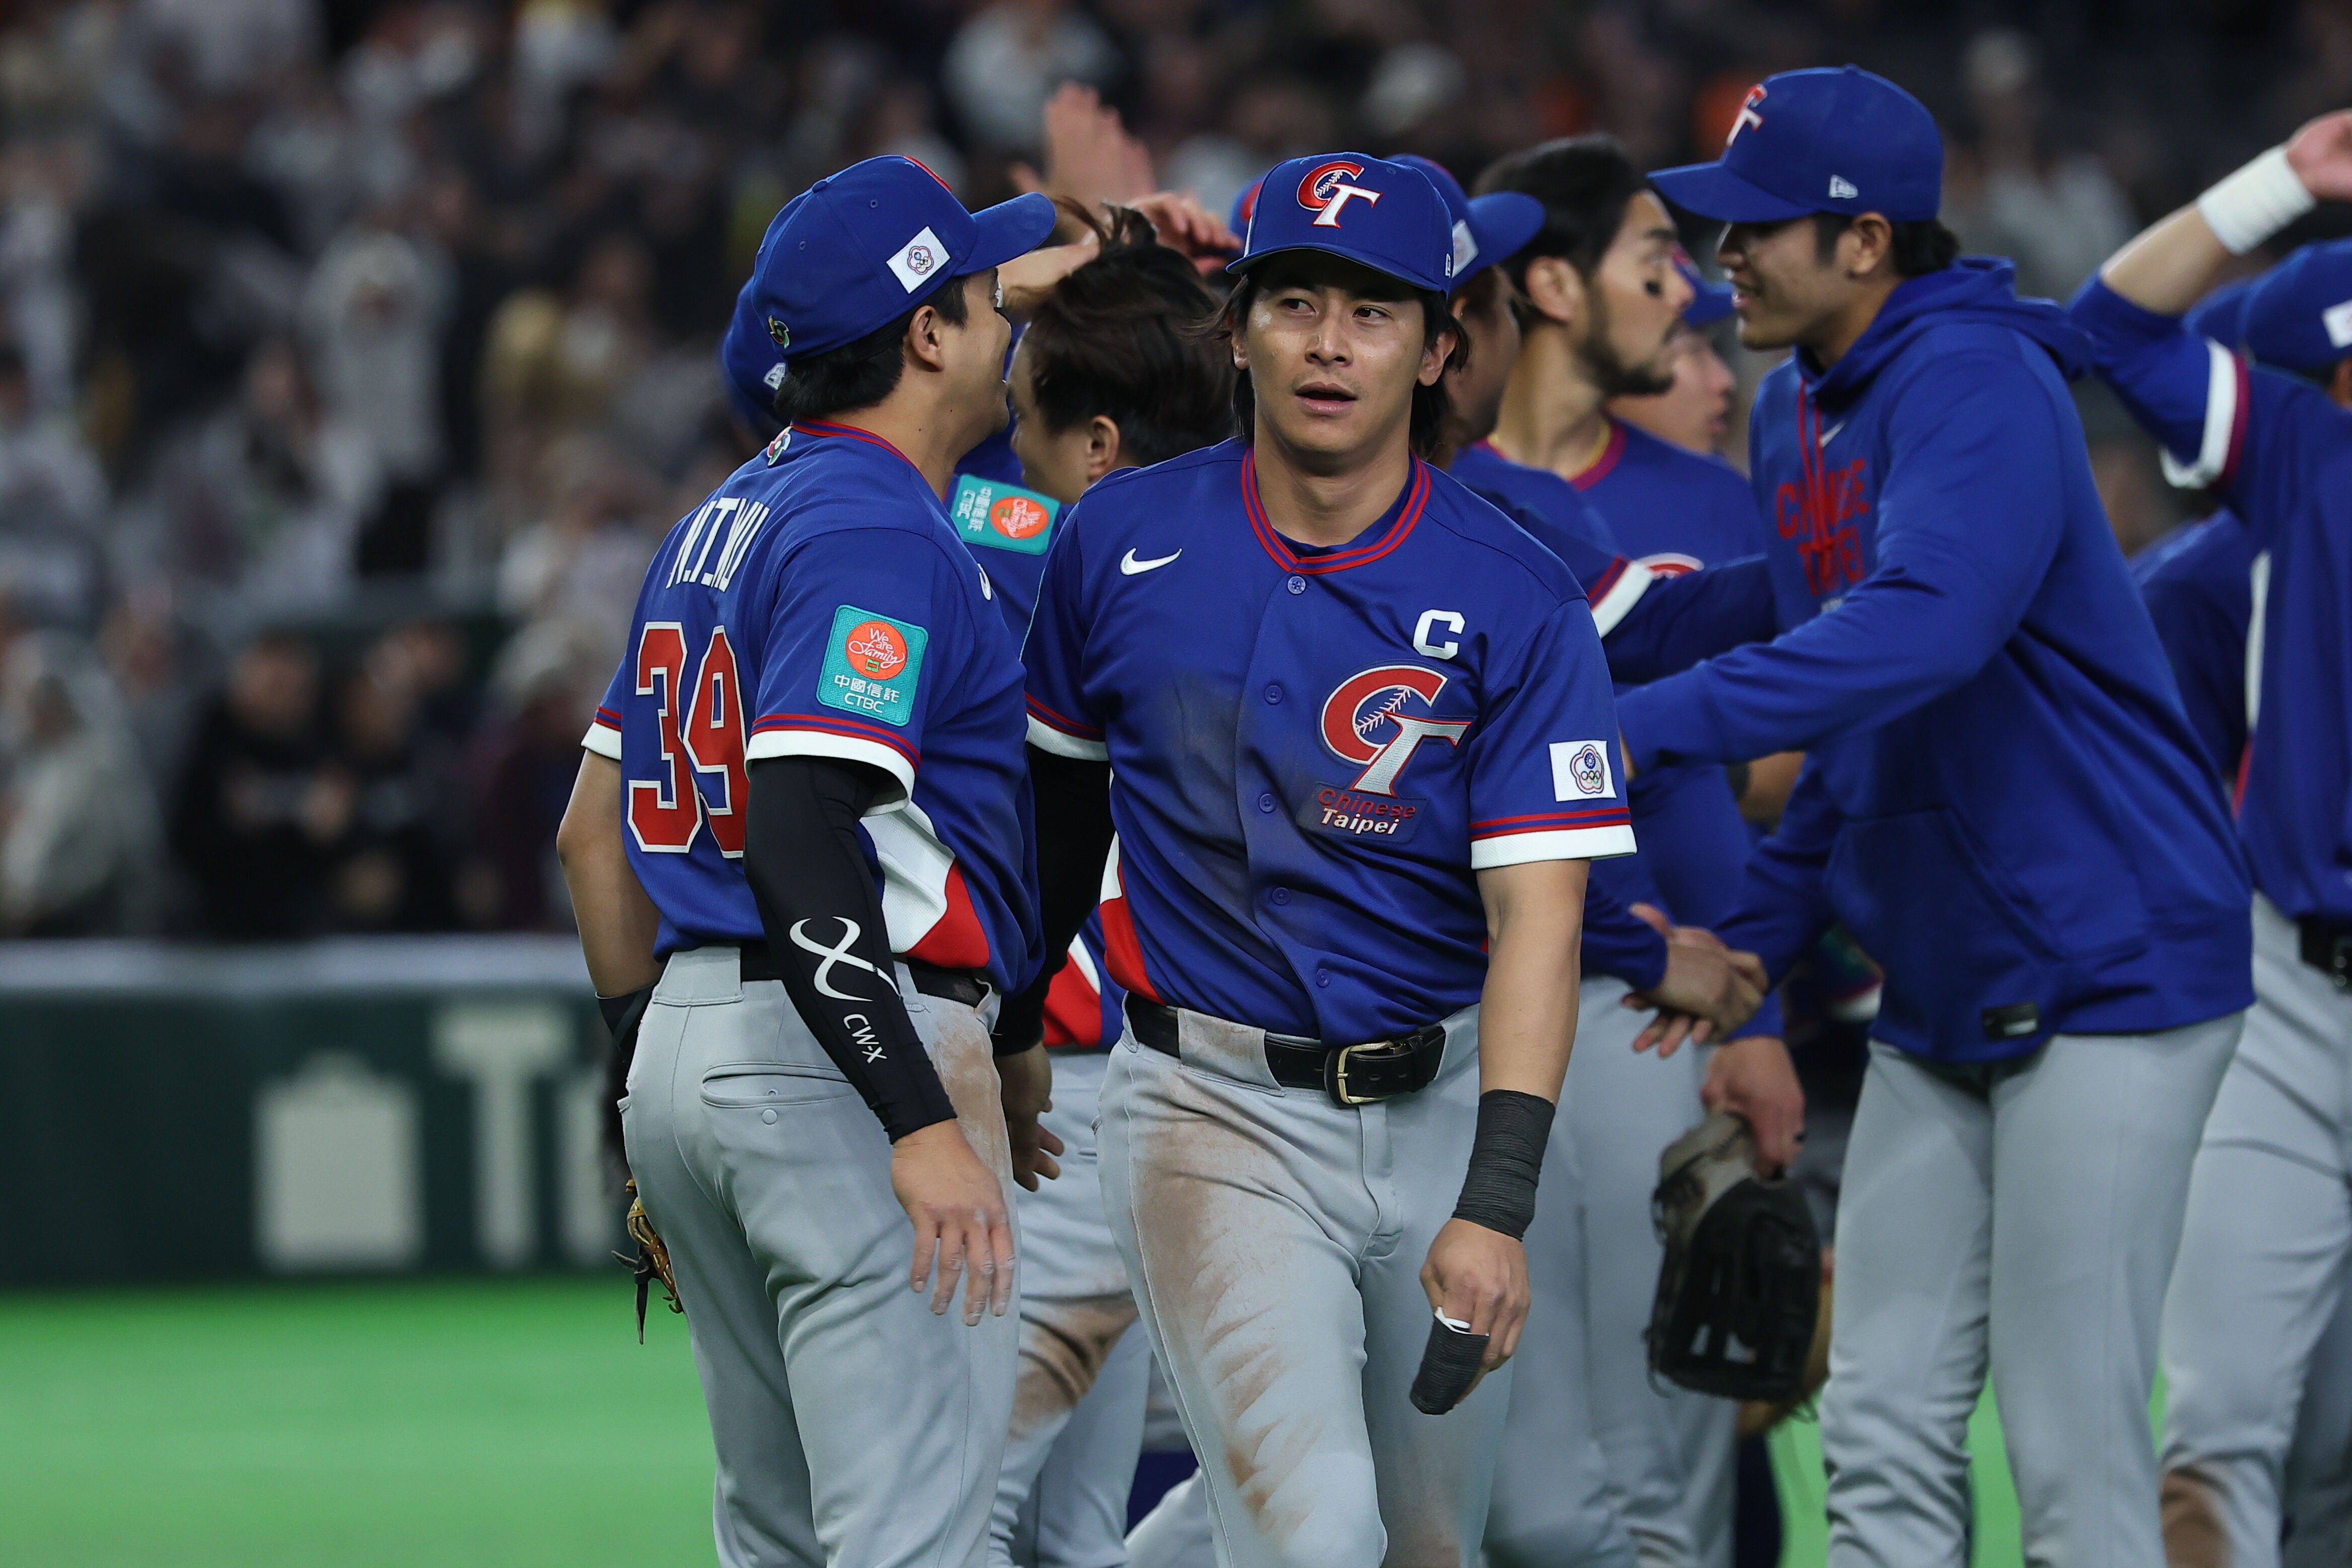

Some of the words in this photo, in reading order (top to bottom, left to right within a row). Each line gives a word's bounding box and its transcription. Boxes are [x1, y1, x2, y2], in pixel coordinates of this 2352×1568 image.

[957, 489, 976, 520] CTBC
[869, 627, 890, 644] We
[875, 641, 893, 652] are
[1412, 608, 1466, 661] C
[833, 674, 901, 703] 中國信託
[844, 692, 885, 714] CTBC
[627, 621, 750, 859] 39
[1317, 788, 1417, 819] Chinese
[1320, 806, 1401, 836] Taipei
[842, 1013, 888, 1064] CW-X
